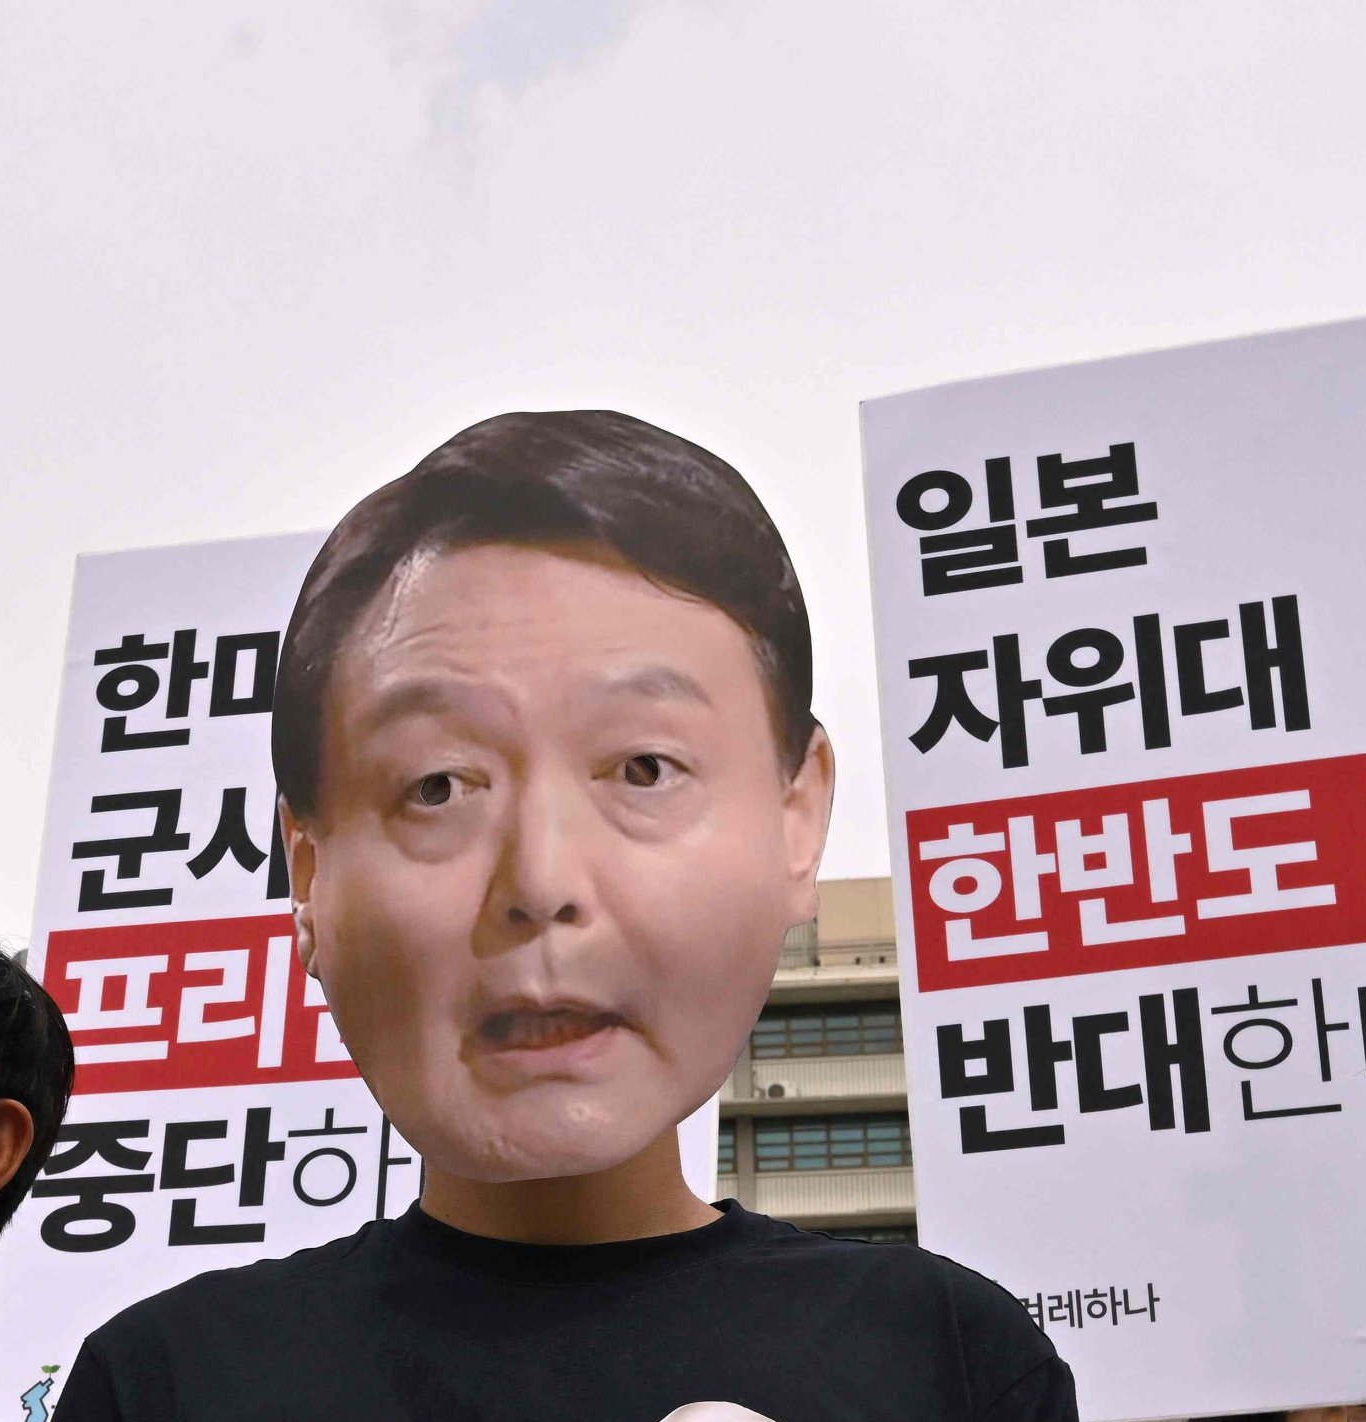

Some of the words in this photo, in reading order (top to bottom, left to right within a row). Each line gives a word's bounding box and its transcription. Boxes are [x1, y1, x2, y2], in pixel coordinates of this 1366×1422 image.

[896, 441, 1158, 597] 일본
[908, 594, 1311, 769] 자위대
[919, 789, 1337, 961] 한반도
[61, 934, 346, 1069] 프리
